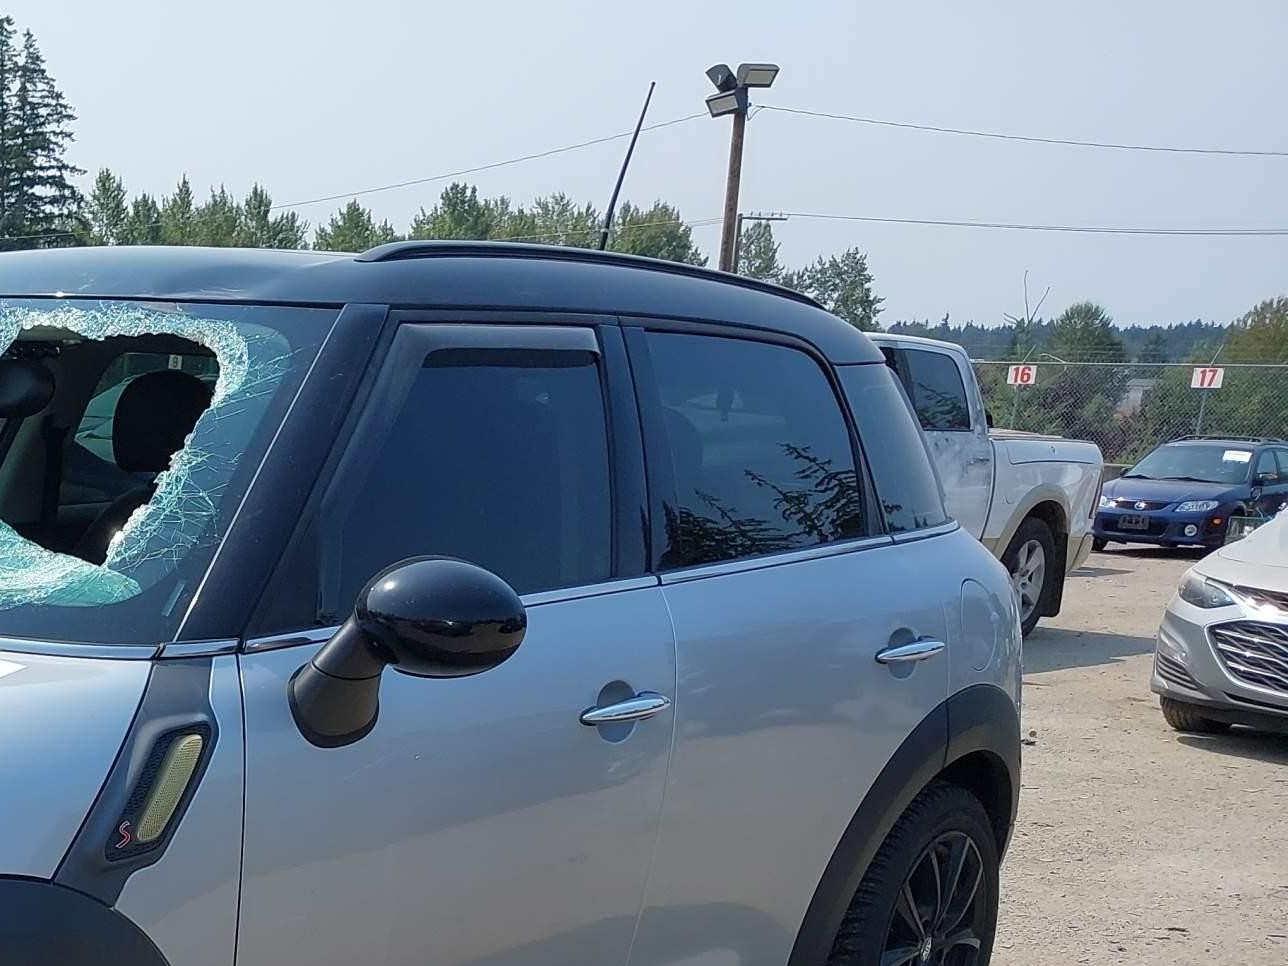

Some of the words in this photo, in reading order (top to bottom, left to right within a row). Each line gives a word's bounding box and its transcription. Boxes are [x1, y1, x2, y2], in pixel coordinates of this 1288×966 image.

[1013, 366, 1032, 384] 16
[1200, 368, 1218, 387] 17
[115, 820, 131, 849] S
